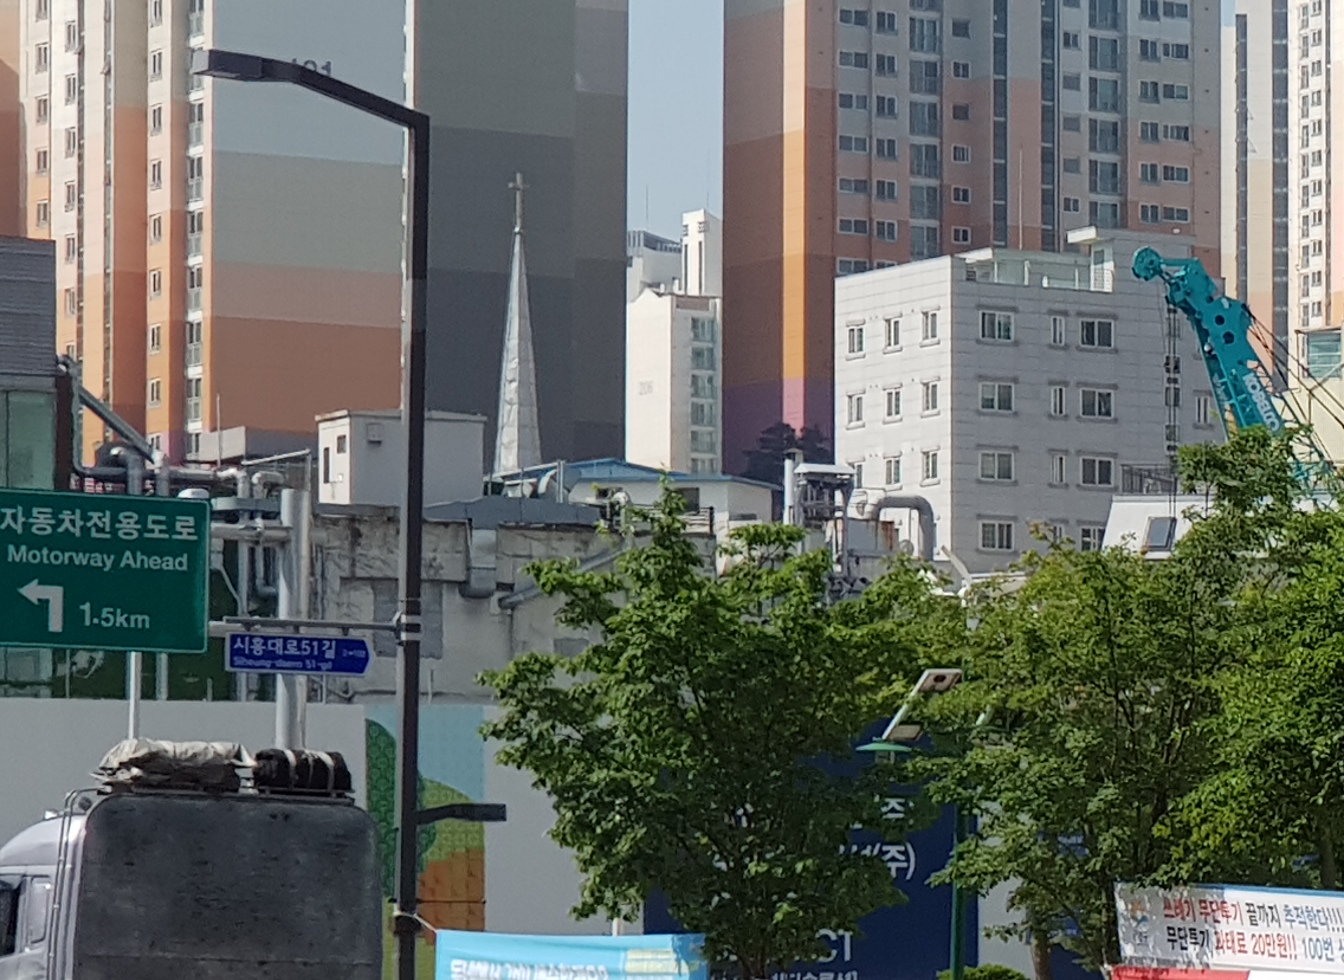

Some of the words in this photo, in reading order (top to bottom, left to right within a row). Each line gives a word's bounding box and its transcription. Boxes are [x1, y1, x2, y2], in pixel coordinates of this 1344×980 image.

[0, 504, 199, 541] 자동차전용도로
[6, 543, 115, 572] Motorway
[119, 550, 189, 571] Ahead
[79, 601, 151, 629] 1.5km
[233, 635, 337, 660] 시흥대로51길
[1163, 896, 1196, 923] 쓰레기
[1199, 898, 1244, 924] 무단투기
[1245, 901, 1281, 929] 끝까지
[1166, 924, 1213, 953] 무단투기
[1214, 928, 1247, 956] 과태료
[1250, 932, 1297, 961] 20만원!!
[1300, 935, 1335, 962] 100번
